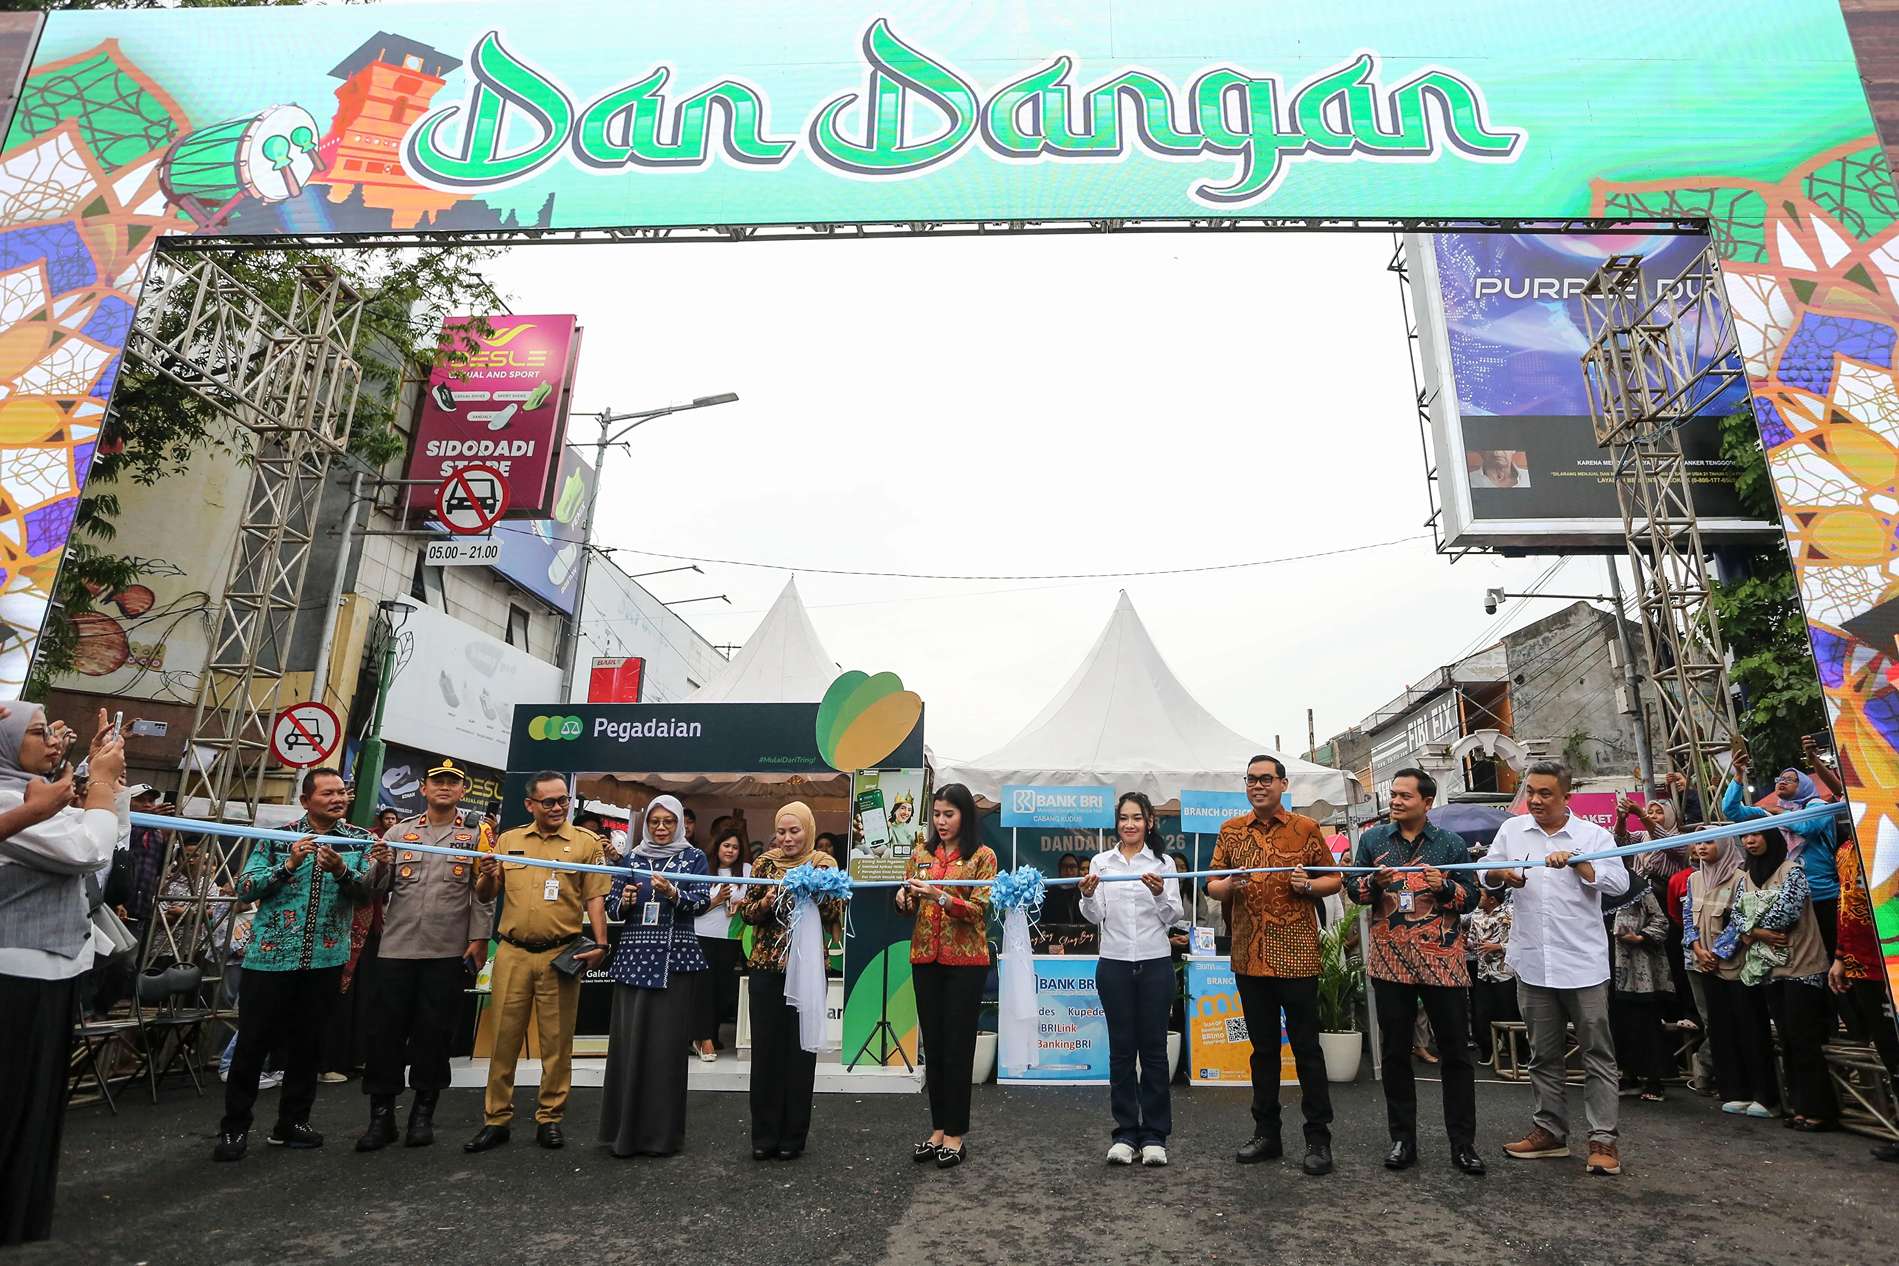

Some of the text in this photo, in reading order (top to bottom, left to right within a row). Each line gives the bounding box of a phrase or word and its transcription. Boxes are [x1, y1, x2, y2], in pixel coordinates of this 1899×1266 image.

[405, 18, 1521, 203] Dan Dangan
[486, 370, 507, 378] AND
[509, 370, 540, 378] SPORT
[426, 440, 535, 456] SIDODADI
[429, 546, 458, 559] 05.00
[469, 545, 498, 558] 21.00
[593, 718, 702, 742] Pegadaian
[1036, 795, 1103, 808] BANK BRI
[1184, 808, 1219, 817] BRANCH
[1033, 815, 1083, 823] CABANG KUDUS
[1583, 814, 1612, 823] AKET
[586, 969, 609, 978] Galer
[1040, 978, 1096, 990] BANK BR
[1068, 1007, 1105, 1018] Kupede
[1041, 1023, 1077, 1034] BRILink
